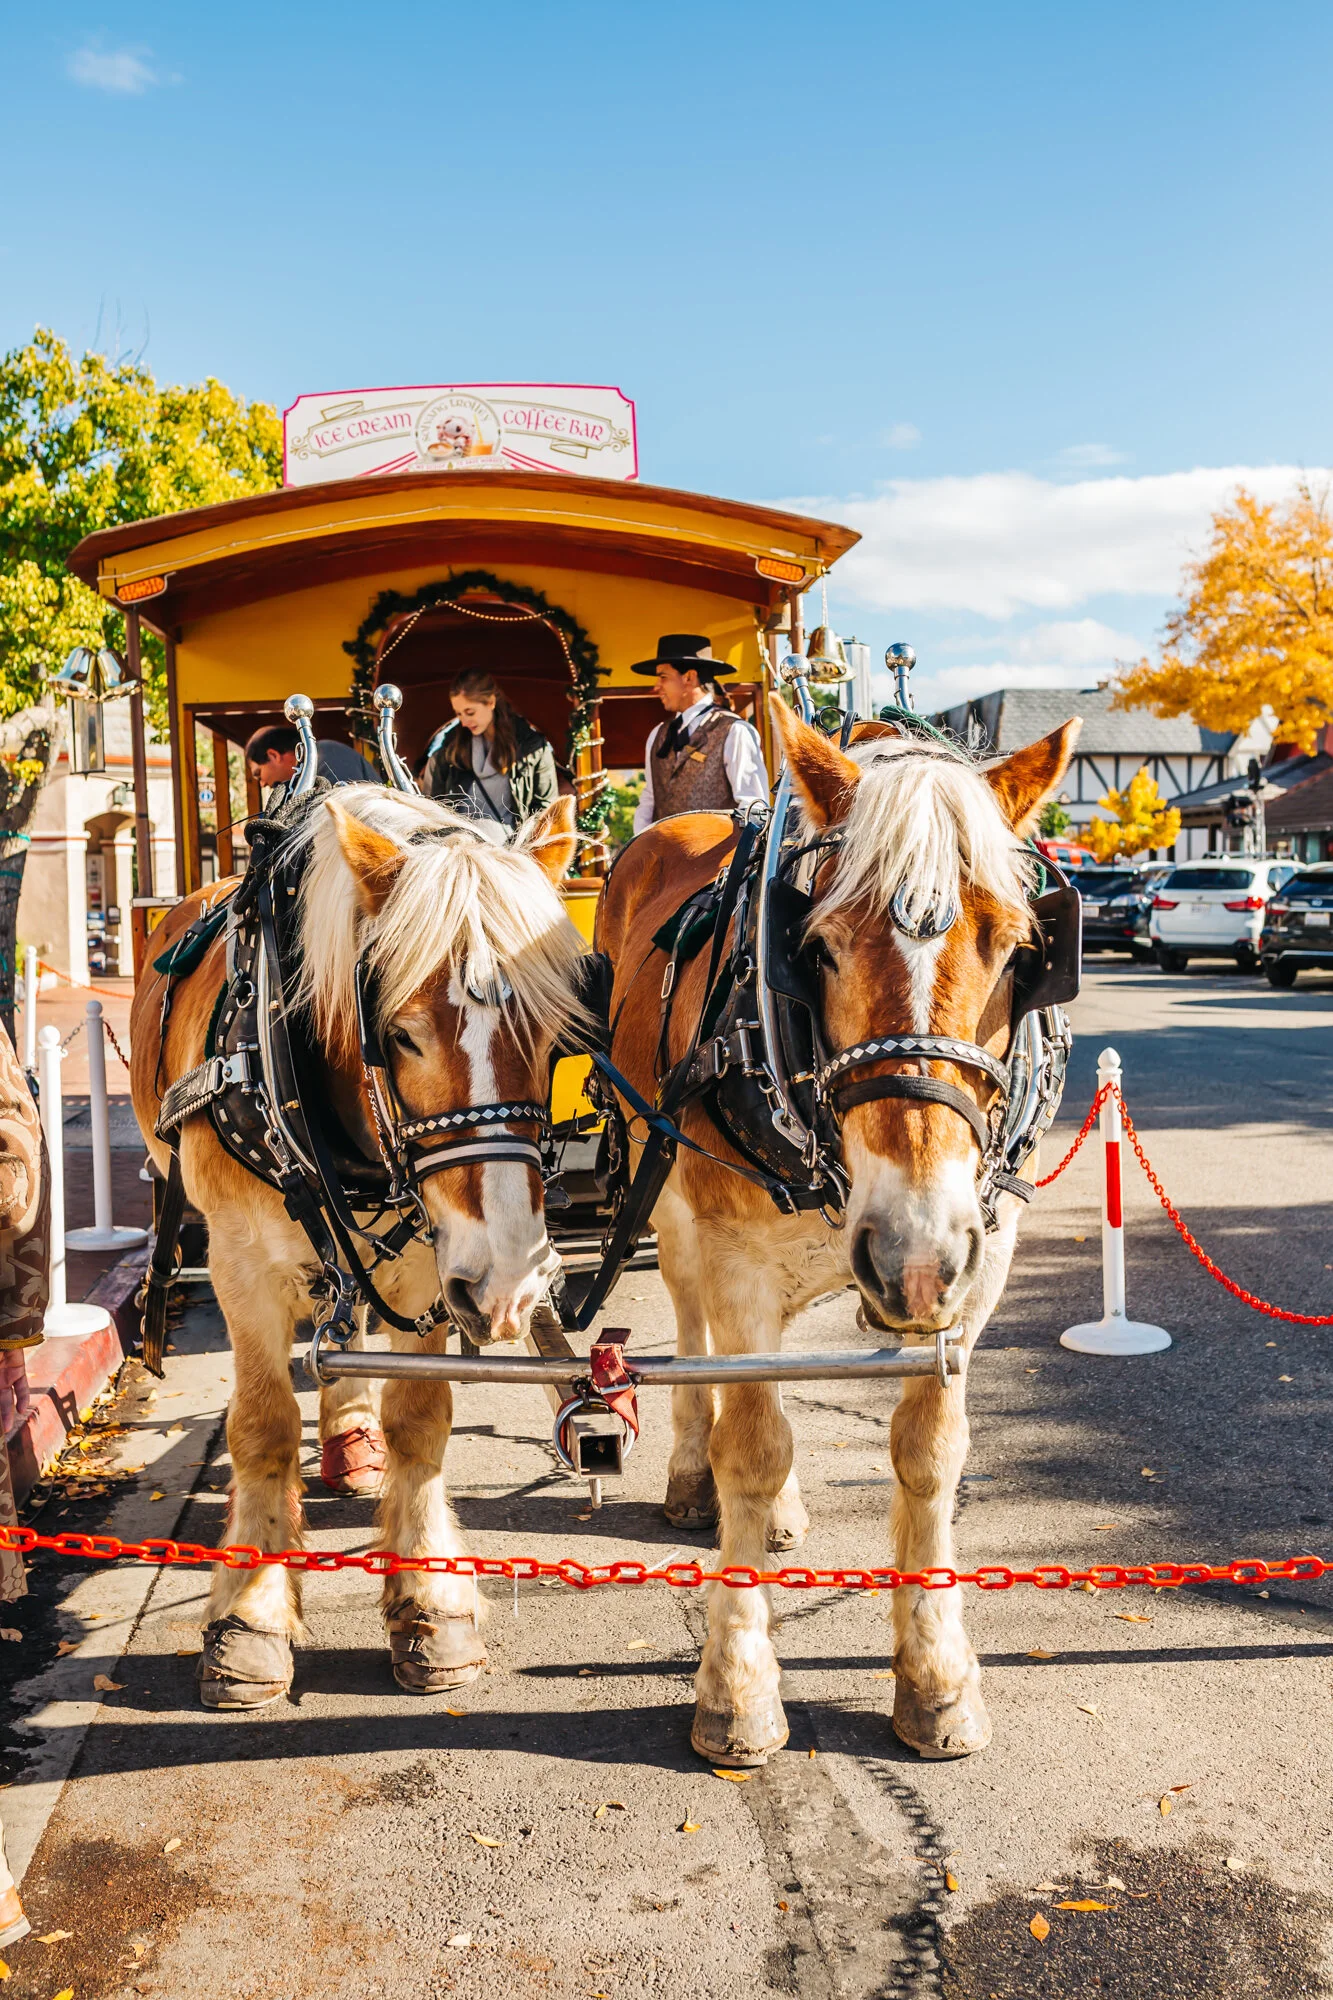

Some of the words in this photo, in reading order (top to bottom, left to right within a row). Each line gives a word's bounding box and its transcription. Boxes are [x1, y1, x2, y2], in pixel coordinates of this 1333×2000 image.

[314, 427, 345, 449] ICE
[346, 412, 412, 439] CREAM
[503, 407, 567, 432] COFFEE
[568, 418, 603, 442] BAR
